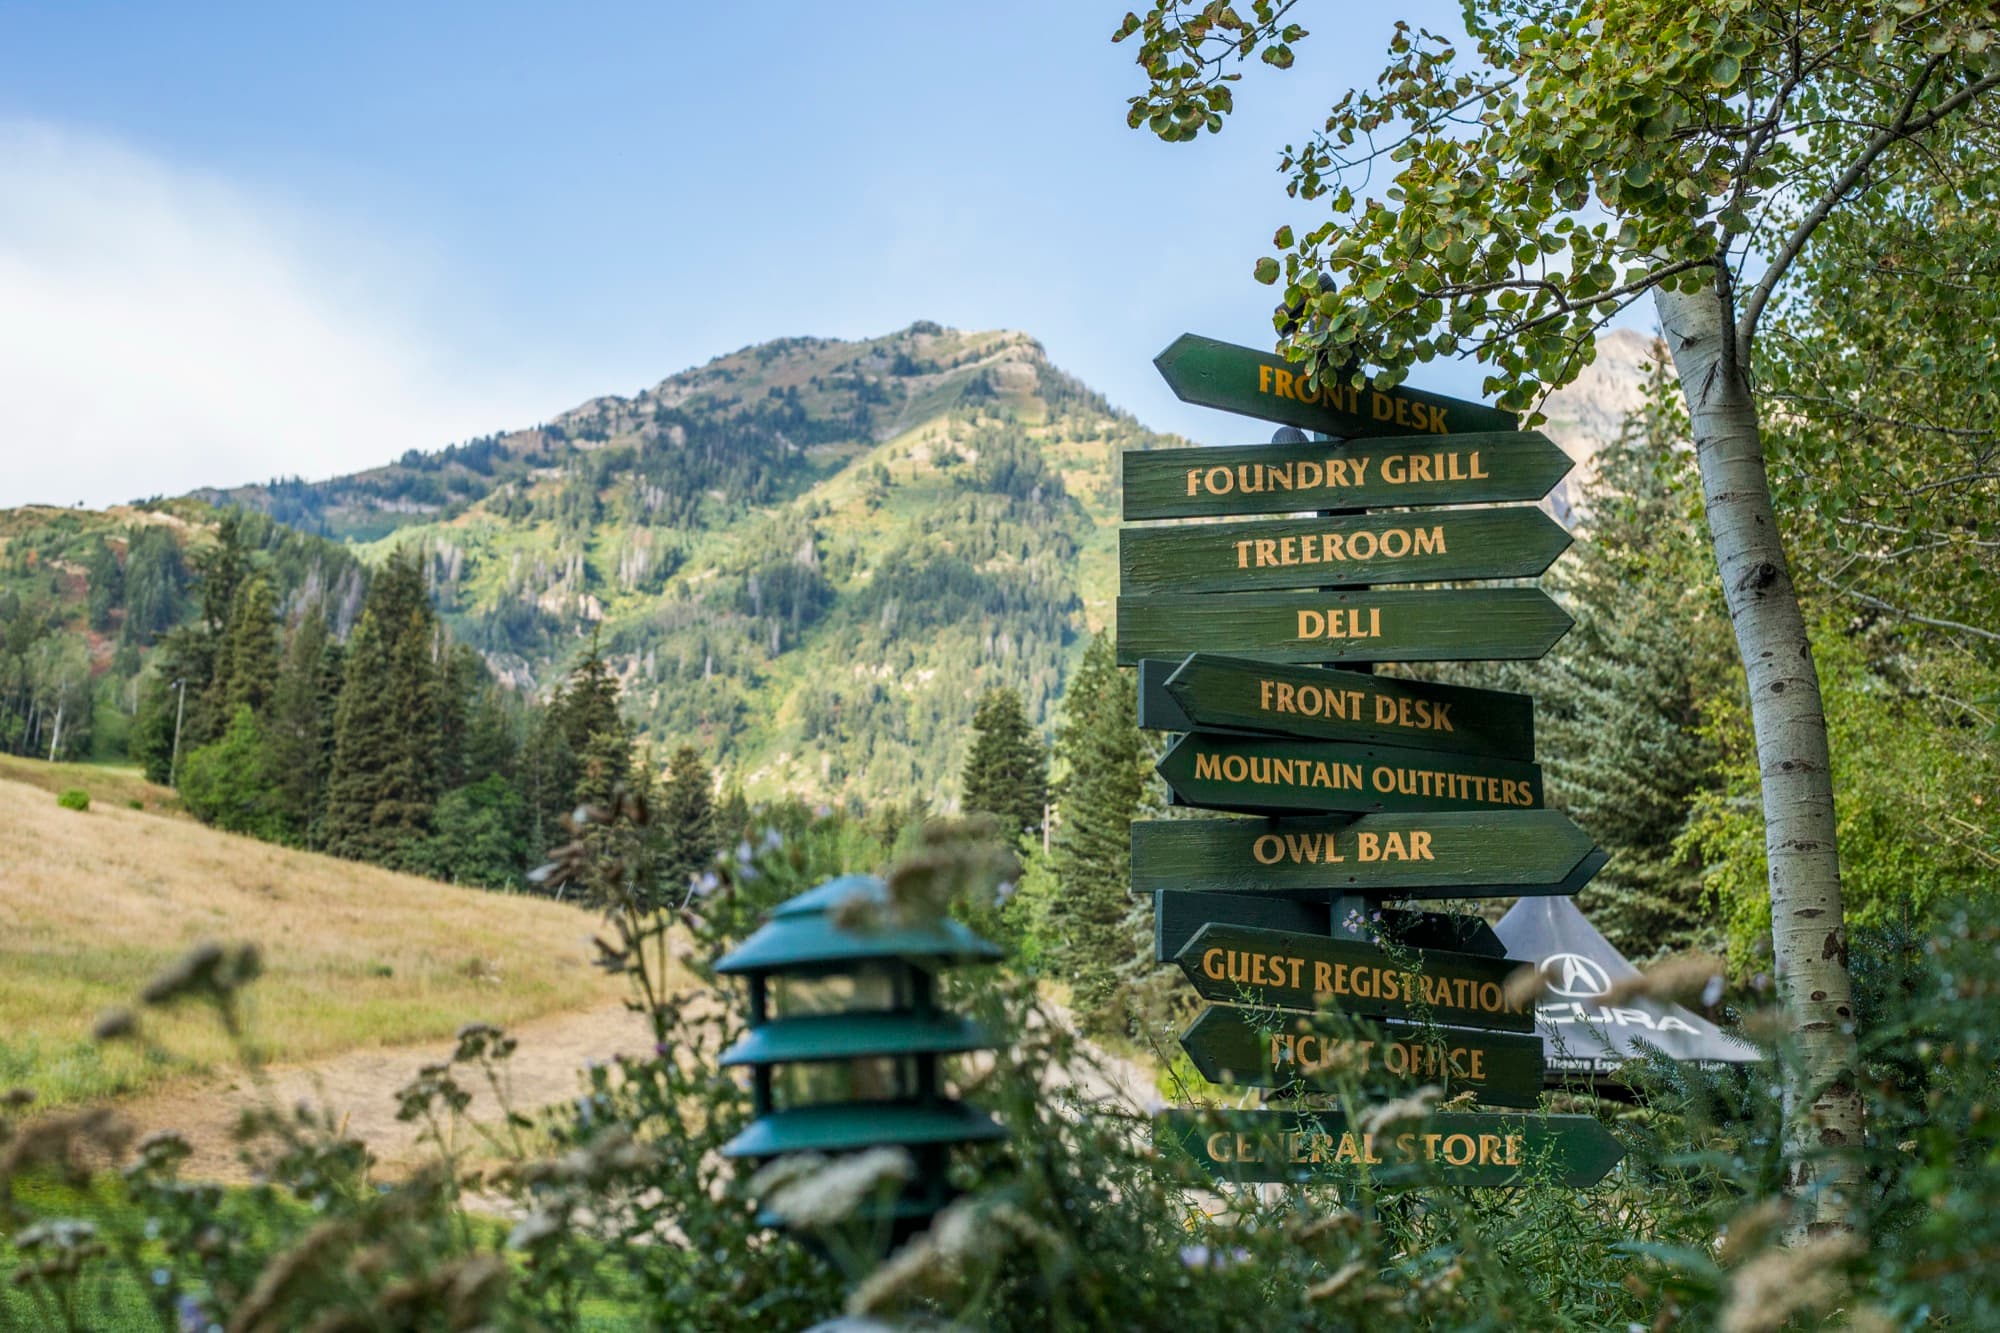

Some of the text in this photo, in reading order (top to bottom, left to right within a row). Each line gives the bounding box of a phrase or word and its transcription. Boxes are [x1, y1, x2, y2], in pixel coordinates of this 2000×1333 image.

[1258, 364, 1449, 434] FRONT DESK
[1186, 451, 1489, 497] FOUNDRY GRILL
[1232, 526, 1448, 569] TREEROOM
[1297, 608, 1381, 640] DELI
[1260, 679, 1454, 732] FRONT DESK
[1194, 752, 1534, 806] MOUNTAIN OUTFITTERS
[1253, 831, 1435, 865] OWL BAR
[1203, 947, 1305, 989] GUEST
[1271, 1032, 1375, 1074] TICKT
[1207, 1131, 1524, 1166] GENERAL STORE
